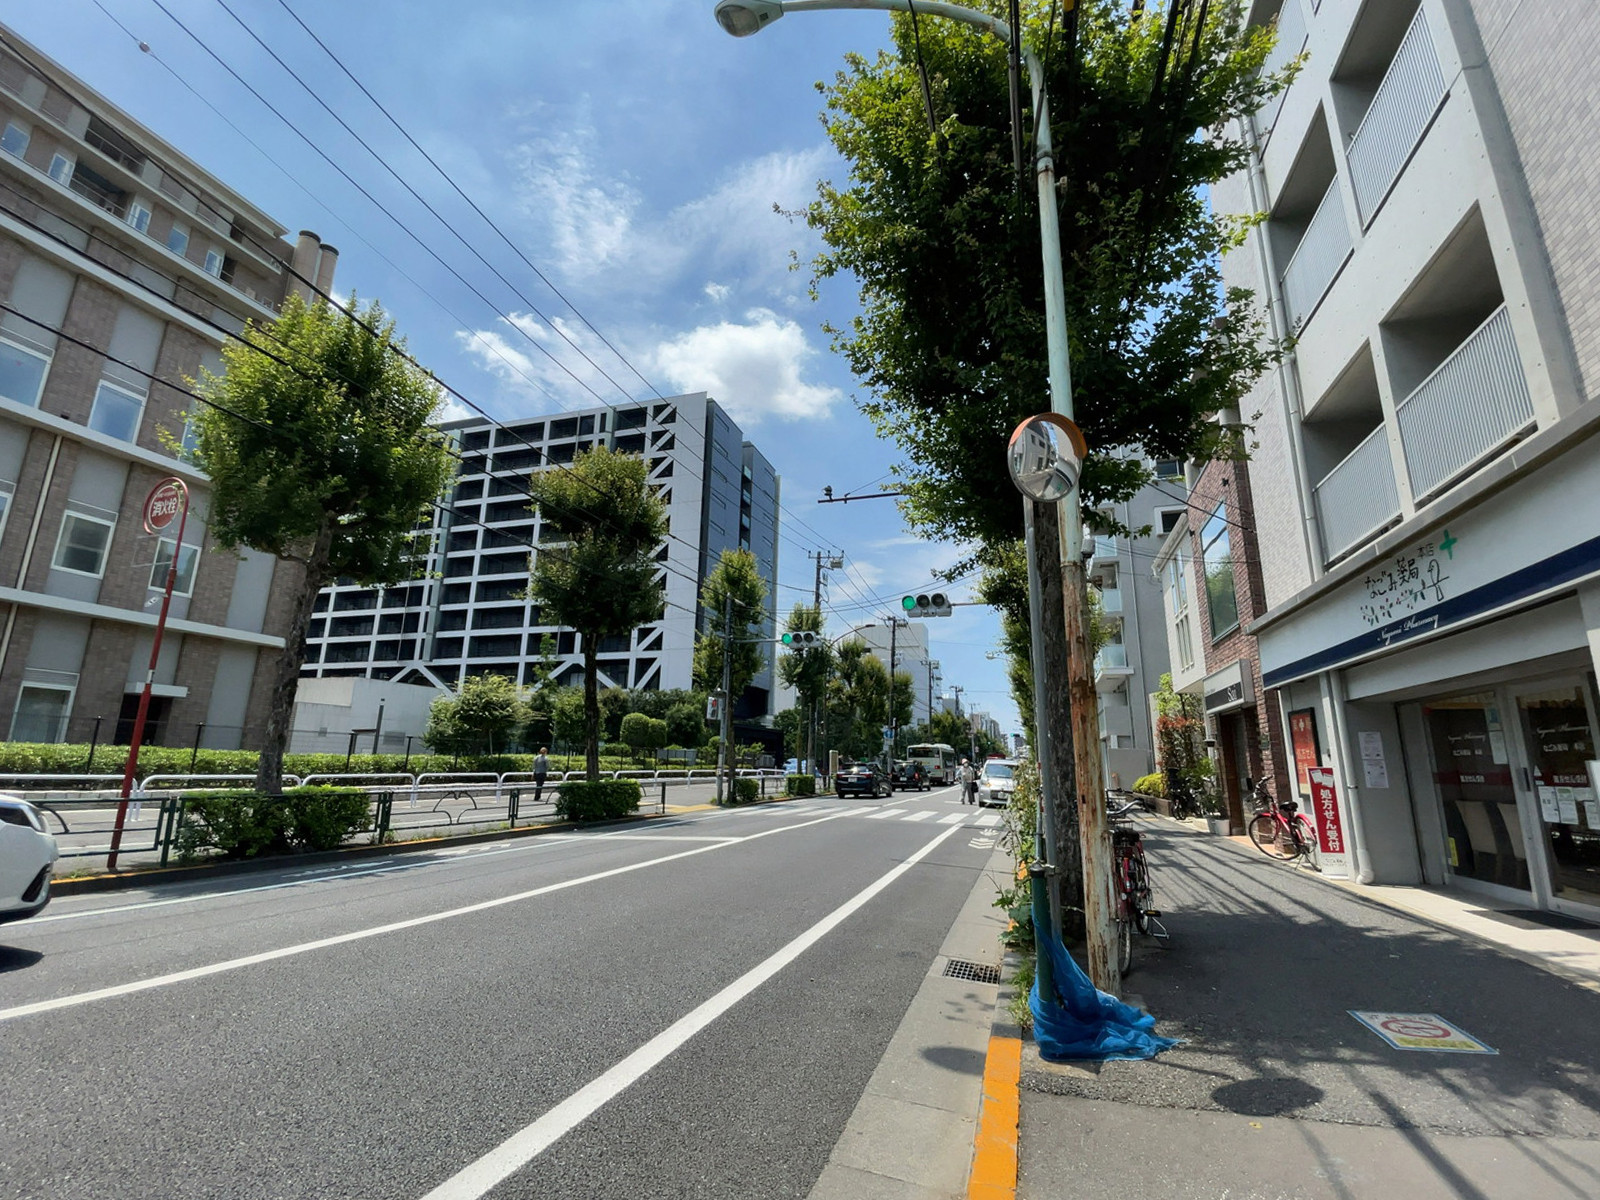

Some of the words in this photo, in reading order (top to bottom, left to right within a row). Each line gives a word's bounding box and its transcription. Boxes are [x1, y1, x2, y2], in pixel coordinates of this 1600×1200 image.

[152, 497, 177, 517] 消火栓
[1403, 614, 1439, 631] Pharmacy
[1320, 788, 1341, 852] 処方せん受付
